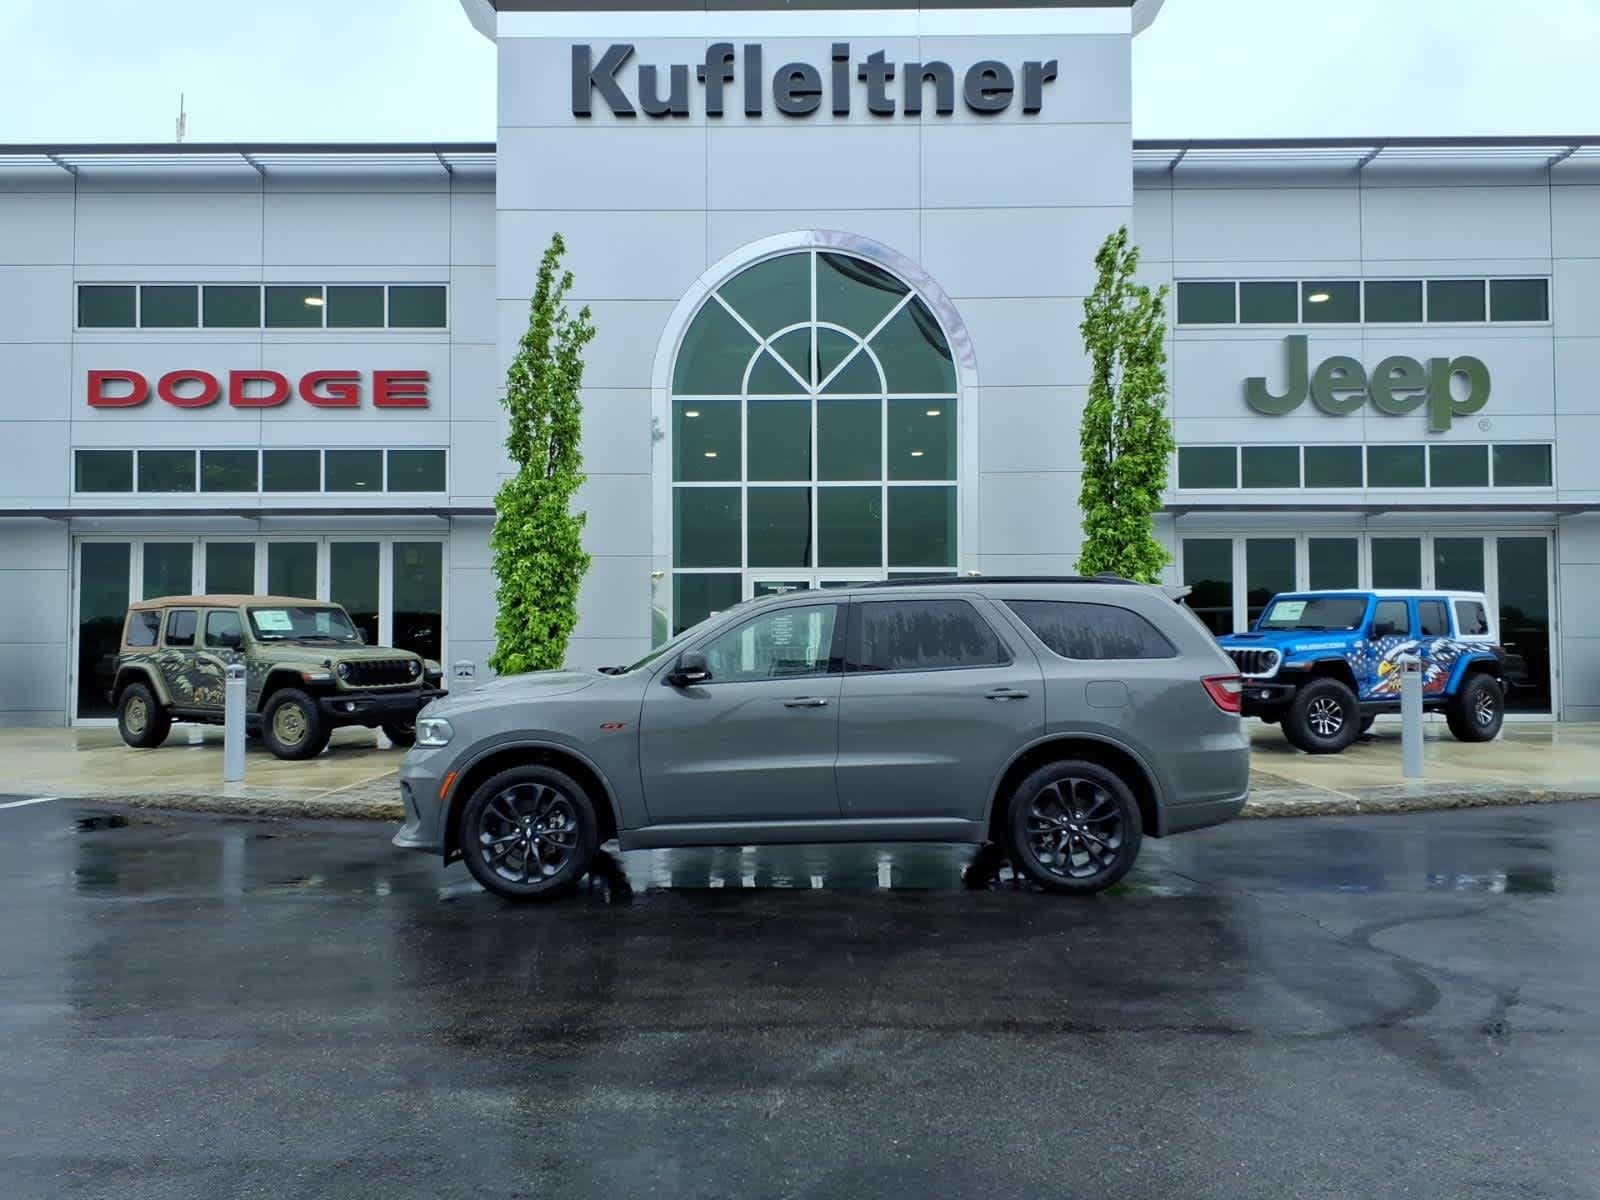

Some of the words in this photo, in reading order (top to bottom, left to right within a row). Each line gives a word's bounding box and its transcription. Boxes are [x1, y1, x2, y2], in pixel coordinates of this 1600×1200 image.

[571, 42, 1058, 119] Kufleitner
[87, 369, 430, 409] DODGE
[1243, 334, 1492, 433] Jeep
